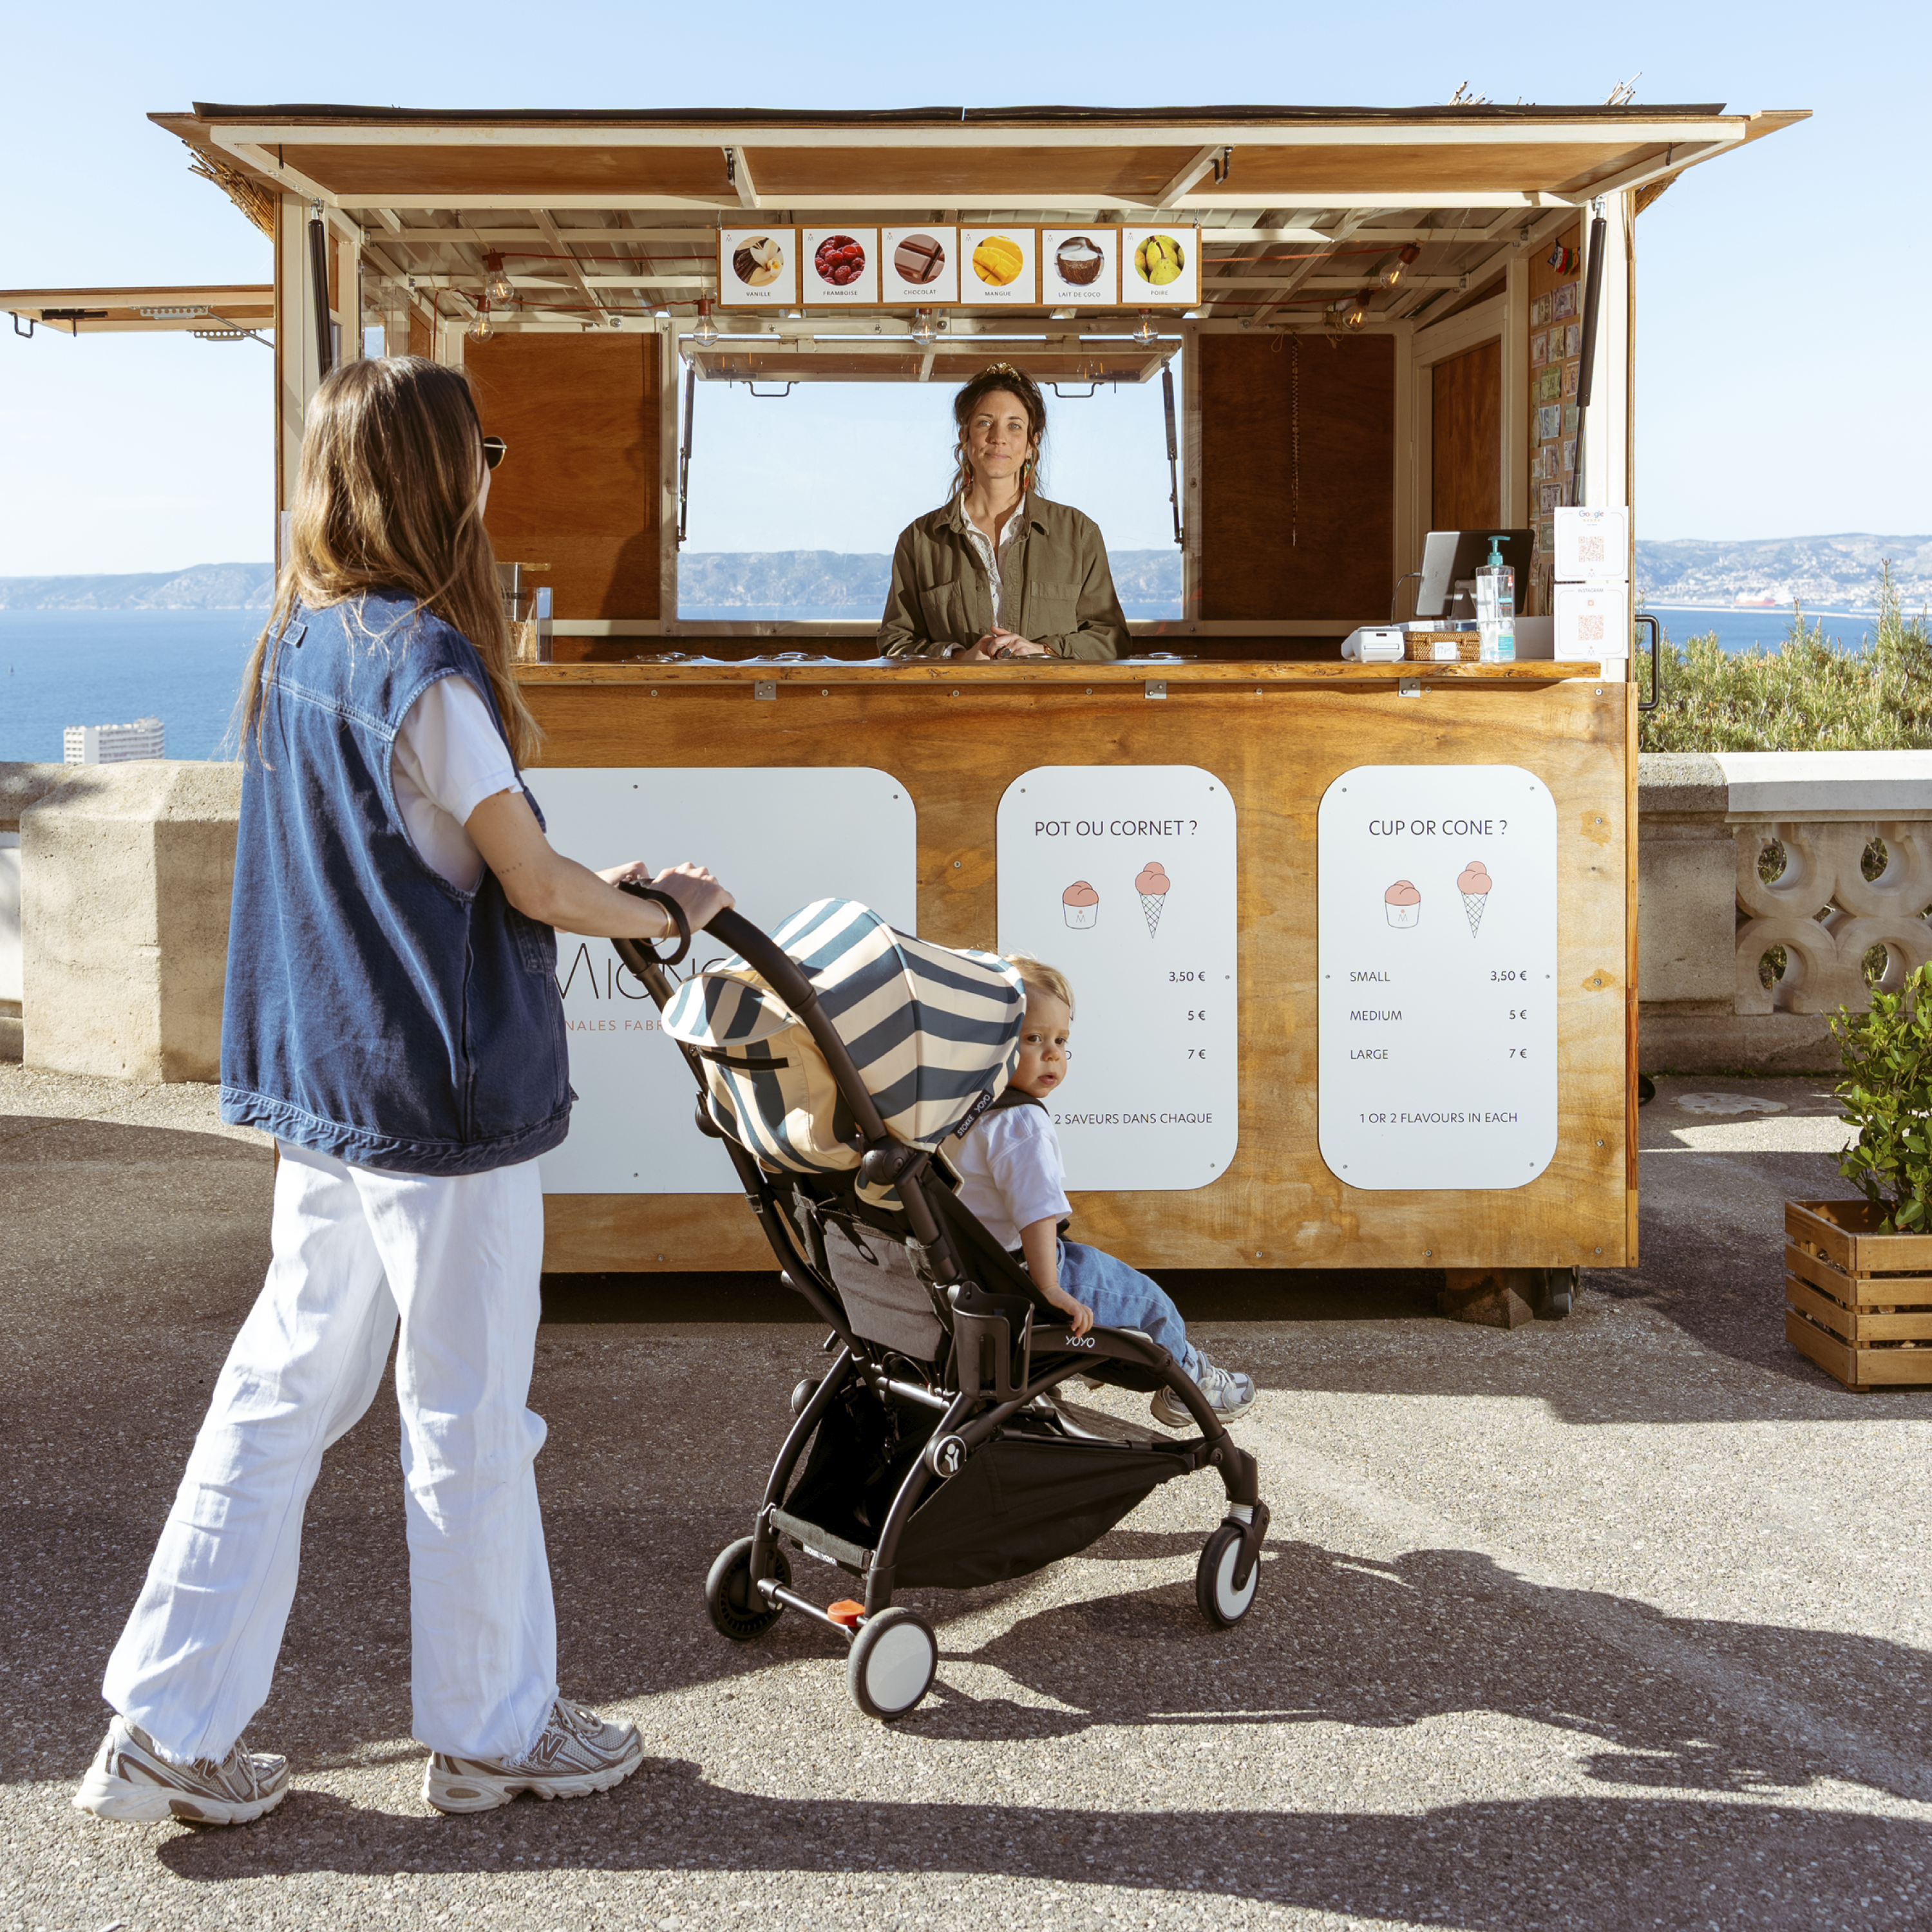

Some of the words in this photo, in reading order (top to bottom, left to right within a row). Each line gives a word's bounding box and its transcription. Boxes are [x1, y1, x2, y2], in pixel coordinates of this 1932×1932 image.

[1578, 510, 1604, 519] Google
[1035, 820, 1072, 837] POT
[1075, 820, 1104, 837] OU
[1110, 820, 1185, 837] CORNET
[1189, 819, 1198, 835] ?
[1368, 819, 1406, 836] CUP
[1410, 819, 1436, 836] OR
[1442, 819, 1493, 836] CONE
[1499, 819, 1508, 835] ?
[1168, 971, 1195, 983] 3,50
[1197, 971, 1206, 982] €
[1350, 971, 1391, 983] SMALL
[1490, 970, 1516, 983] 3,50
[1519, 970, 1528, 981] €
[1187, 1010, 1195, 1021] 5
[1197, 1009, 1206, 1021] €
[1350, 1010, 1403, 1021] MEDIUM
[1509, 1009, 1517, 1020] 5
[1519, 1009, 1528, 1020] €
[565, 1020, 616, 1031] NALES
[1188, 1048, 1195, 1059] 7
[1198, 1048, 1206, 1059] €
[1350, 1048, 1388, 1059] LARGE
[1509, 1048, 1517, 1059] 7
[1519, 1048, 1528, 1059] €
[957, 1114, 974, 1136] STOKKE
[974, 1094, 990, 1113] YOYO
[1054, 1113, 1061, 1125] 2
[1064, 1113, 1119, 1125] SAVEURS
[1122, 1113, 1157, 1124] DANS
[1159, 1113, 1213, 1124] CHAQUE
[1359, 1113, 1365, 1123] 1
[1368, 1113, 1387, 1124] OR
[1390, 1112, 1397, 1123] 2
[1401, 1112, 1464, 1123] FLAVOURS
[1468, 1112, 1481, 1122] IN
[1484, 1112, 1517, 1123] EACH
[1065, 1335, 1095, 1349] YOYO
